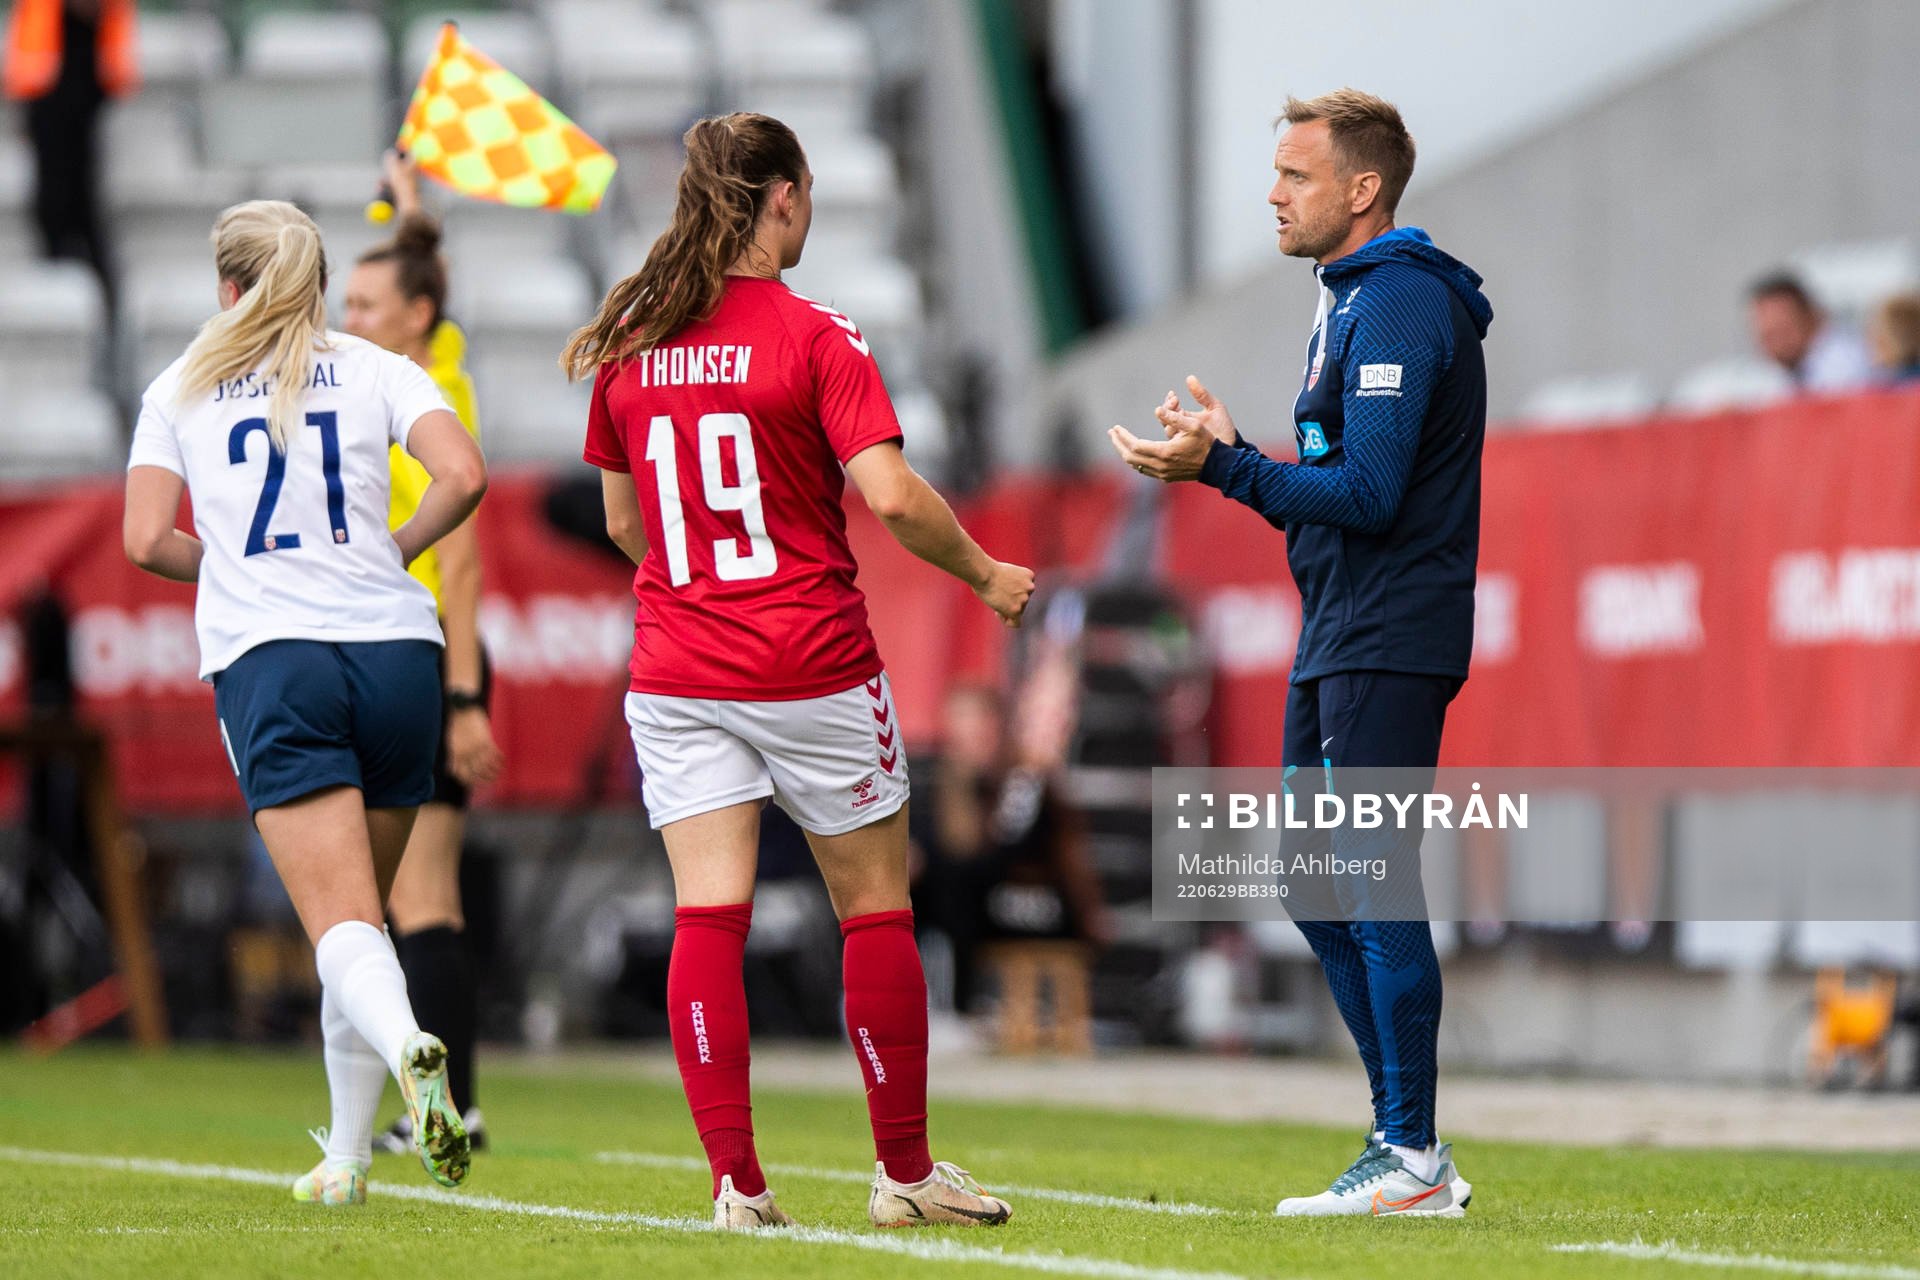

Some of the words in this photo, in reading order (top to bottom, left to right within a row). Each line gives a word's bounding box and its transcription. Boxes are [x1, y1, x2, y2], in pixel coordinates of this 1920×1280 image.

[214, 362, 342, 402] JØSEAL
[640, 345, 752, 388] THOMSEN
[1365, 365, 1398, 387] DNB
[228, 410, 350, 558] 21
[645, 412, 778, 588] 19
[690, 1000, 714, 1065] DANMARK
[857, 1026, 888, 1085] DANMARK
